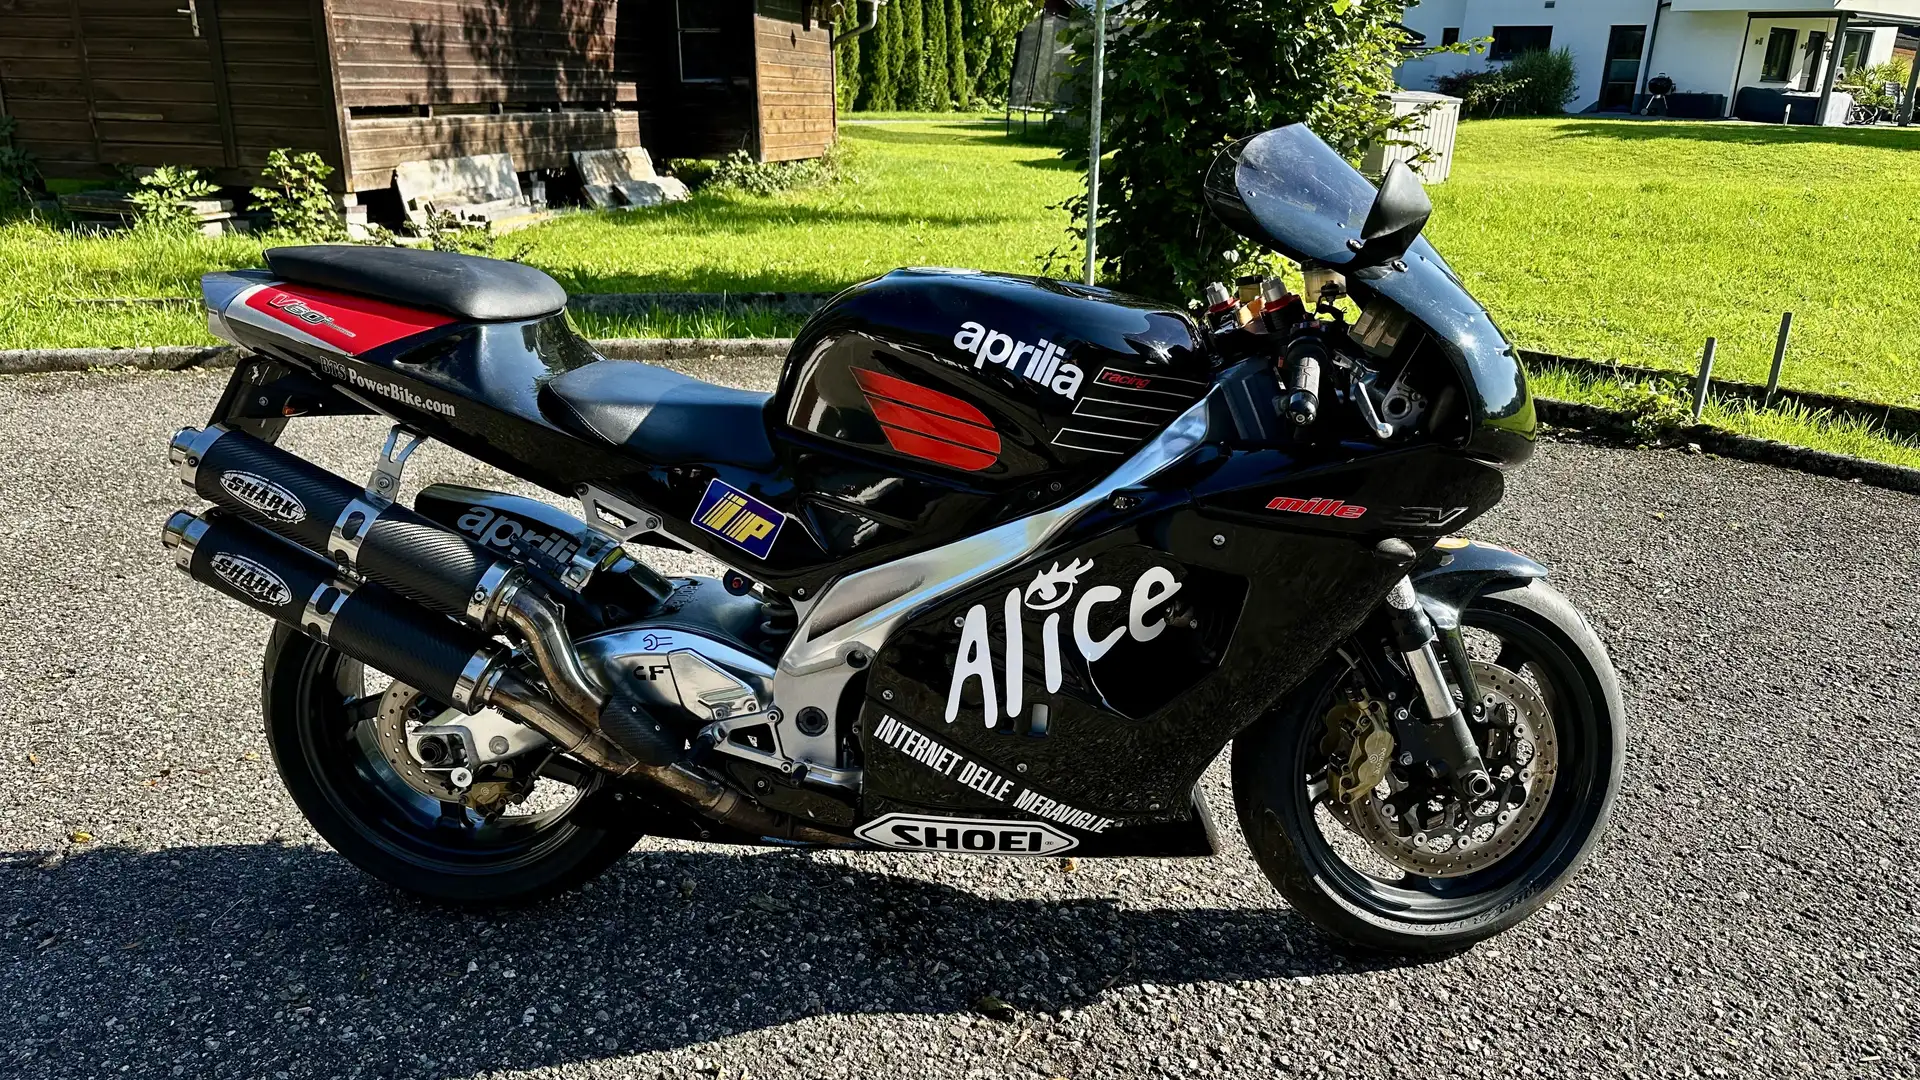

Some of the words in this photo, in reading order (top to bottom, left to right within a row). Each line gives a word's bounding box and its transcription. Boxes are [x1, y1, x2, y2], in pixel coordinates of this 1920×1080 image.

[953, 321, 1084, 399] aprilia
[1102, 371, 1151, 389] racing
[319, 355, 347, 381] BTS
[347, 367, 456, 417] PowerBike.com
[225, 477, 298, 517] SHARK
[1264, 496, 1367, 519] mille
[457, 507, 579, 567] aprili
[215, 558, 284, 600] SHARK
[945, 558, 1182, 729] Alice
[873, 714, 963, 777] INTERNET
[957, 760, 1015, 802] DELLE
[1013, 789, 1115, 834] MERAVIGLIE
[891, 824, 1043, 852] SHOEI
